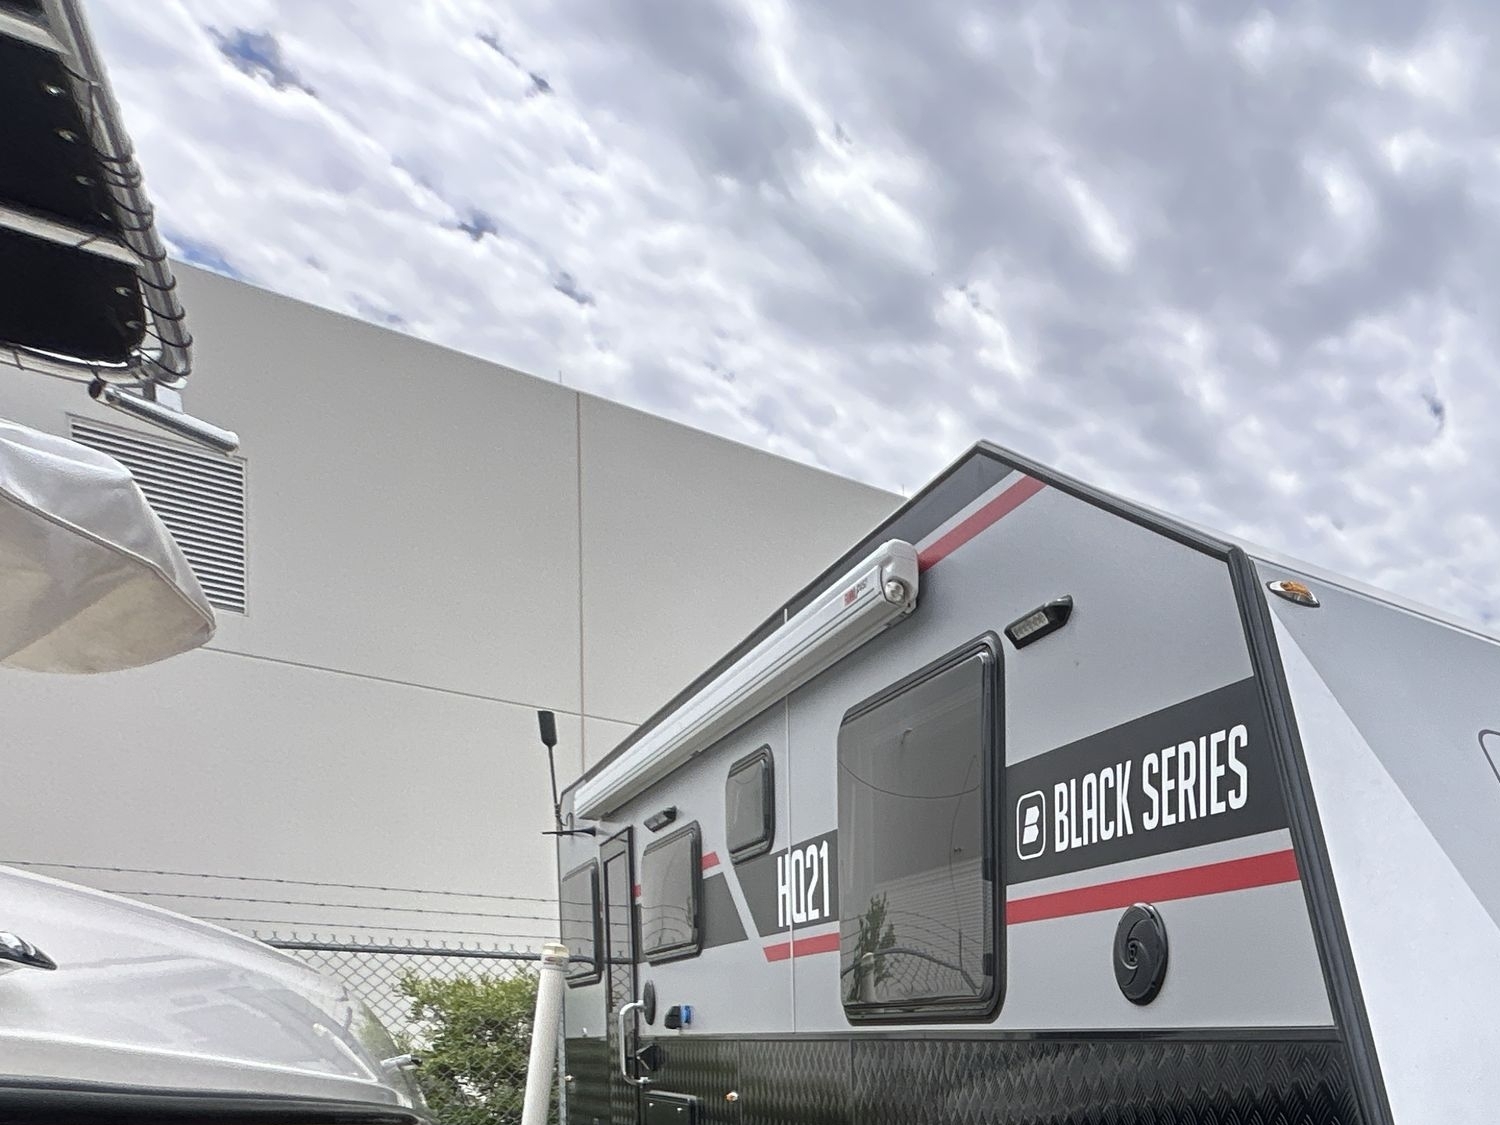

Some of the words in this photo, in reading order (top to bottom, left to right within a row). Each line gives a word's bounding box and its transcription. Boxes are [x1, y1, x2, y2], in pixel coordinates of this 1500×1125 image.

[1053, 759, 1134, 853] BLACK
[1141, 724, 1249, 831] SERIES
[777, 840, 830, 928] HQ21
